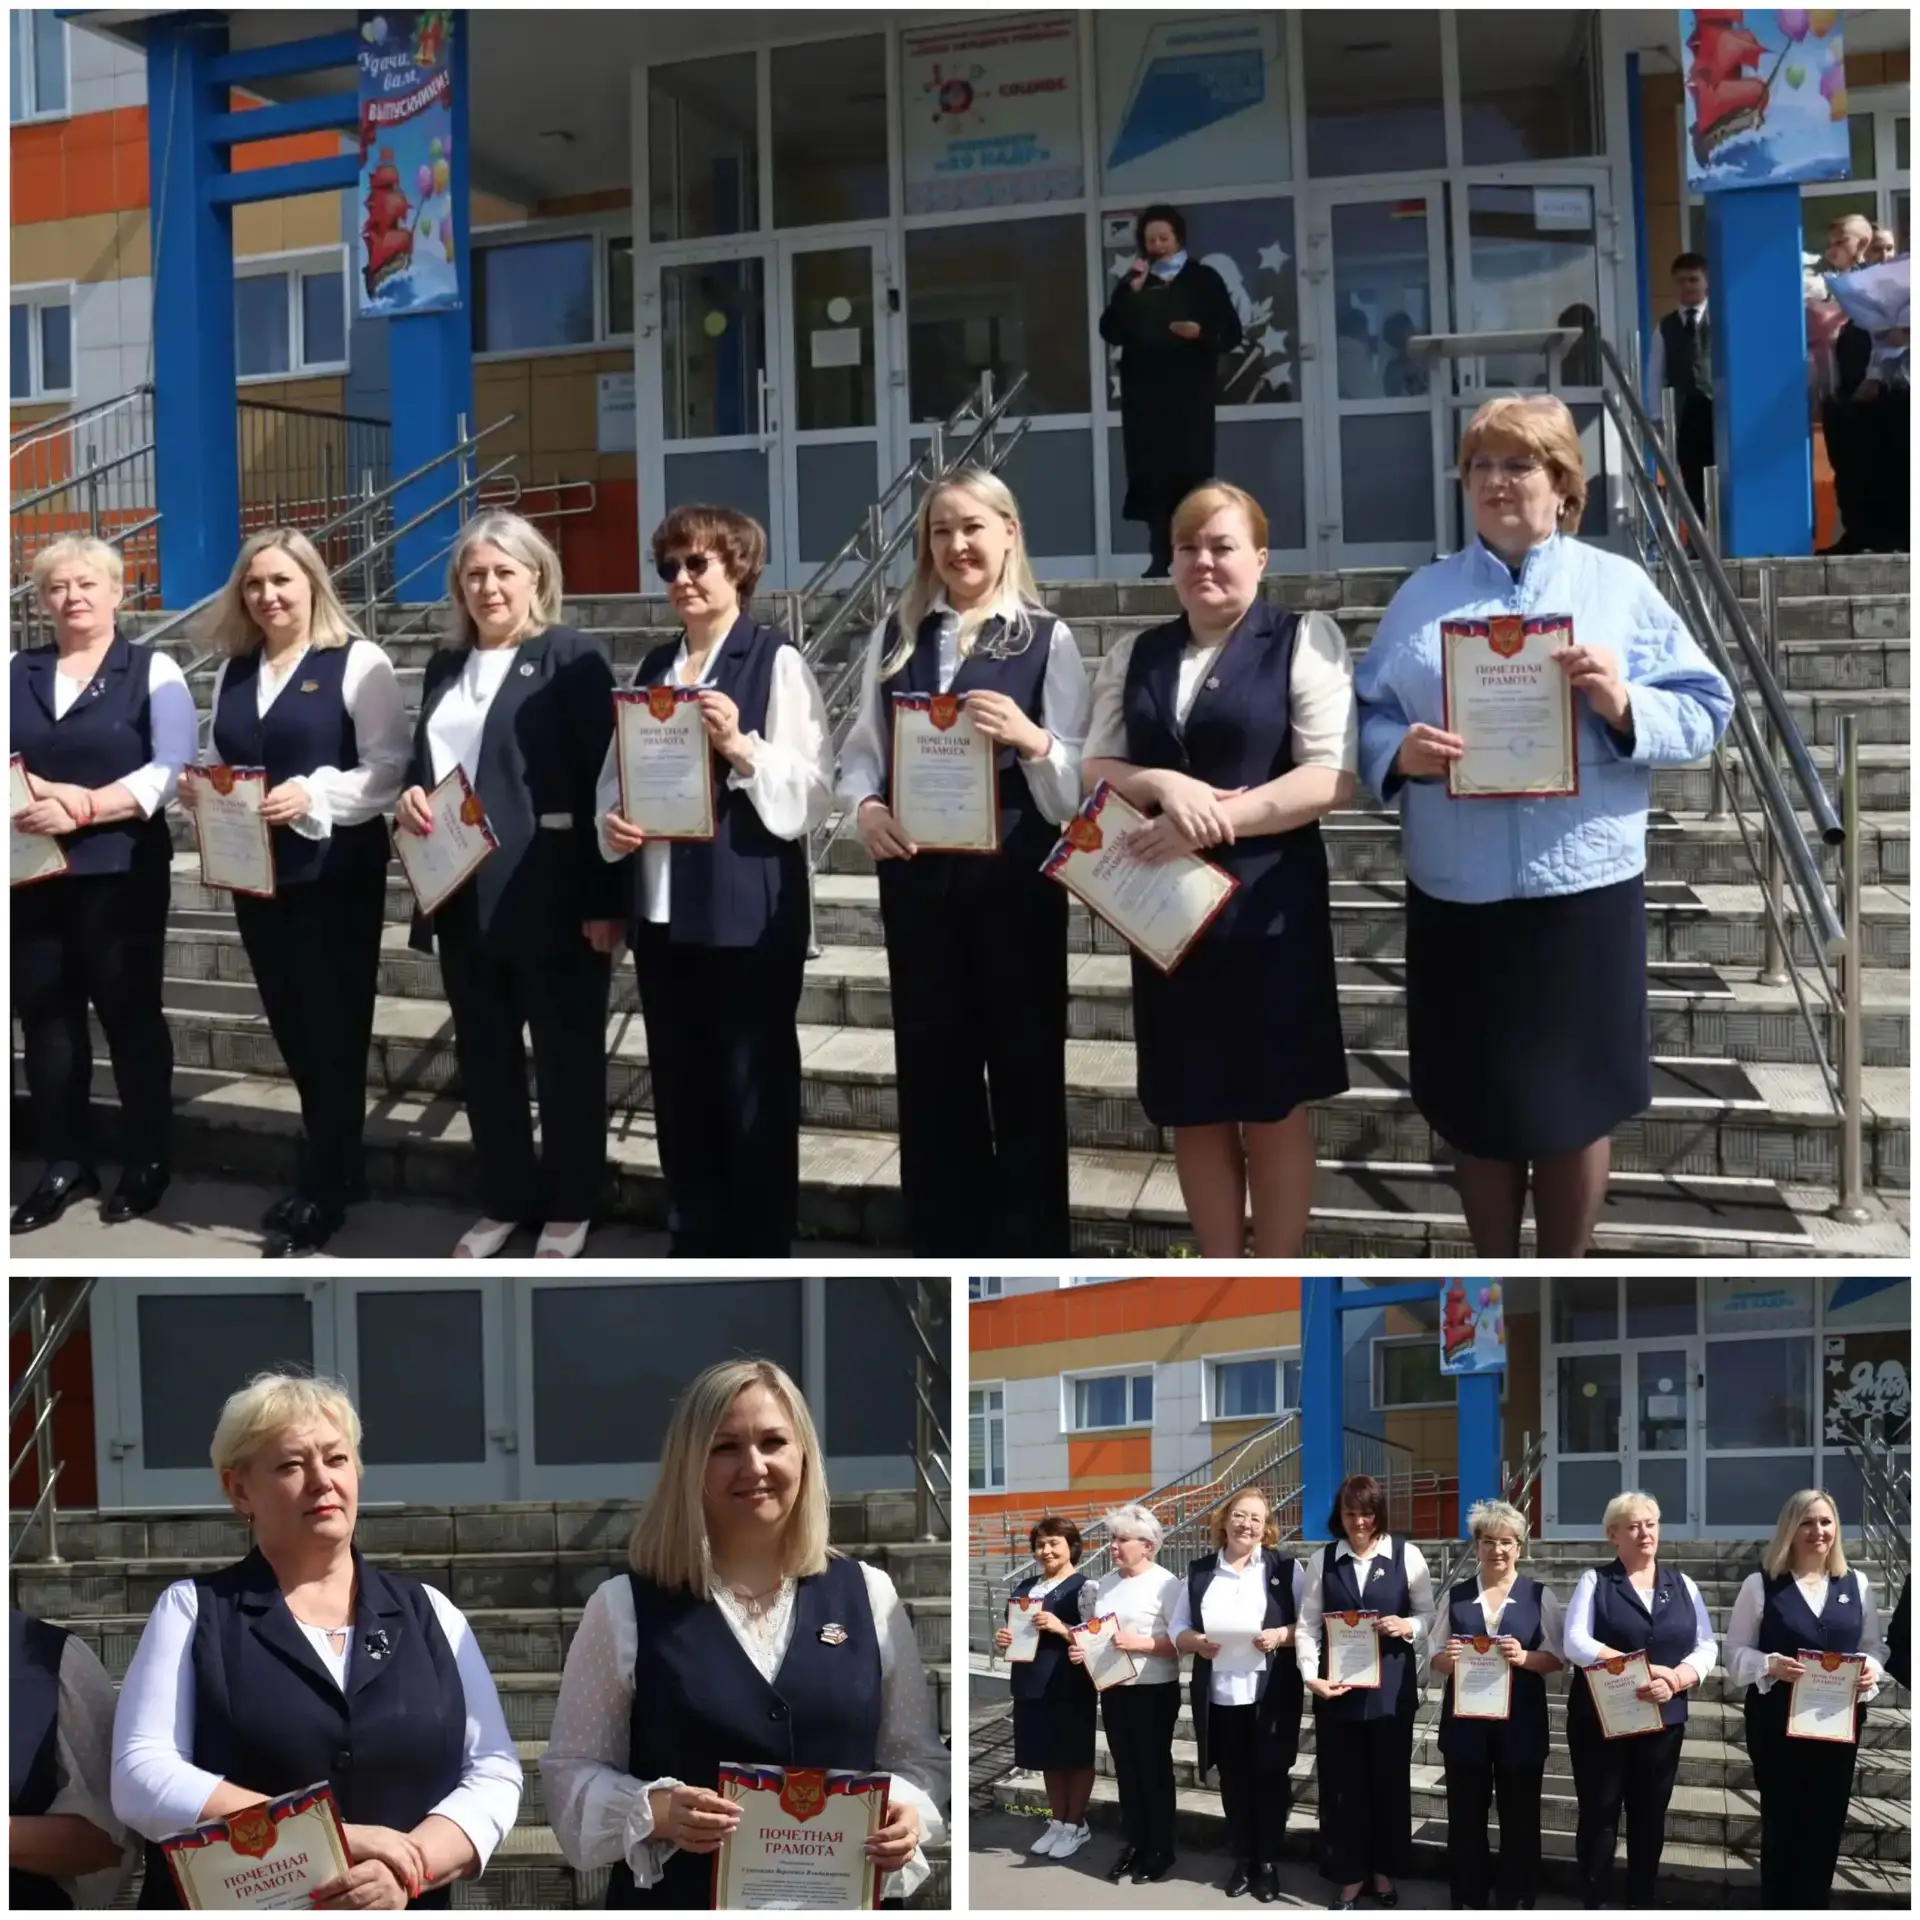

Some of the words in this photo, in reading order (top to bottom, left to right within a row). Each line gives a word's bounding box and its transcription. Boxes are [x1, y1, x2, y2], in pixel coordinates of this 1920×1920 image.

[1475, 664, 1542, 675] ПОЧЕТНАЯ
[1481, 675, 1537, 686] ГРАМОТА
[759, 1828, 844, 1843] ПОЧЕТНАЯ
[765, 1842, 835, 1857] ГРАМОТА
[223, 1852, 309, 1889] ПОЧЕТНАЯ
[235, 1869, 307, 1899] ГРАМОТА
